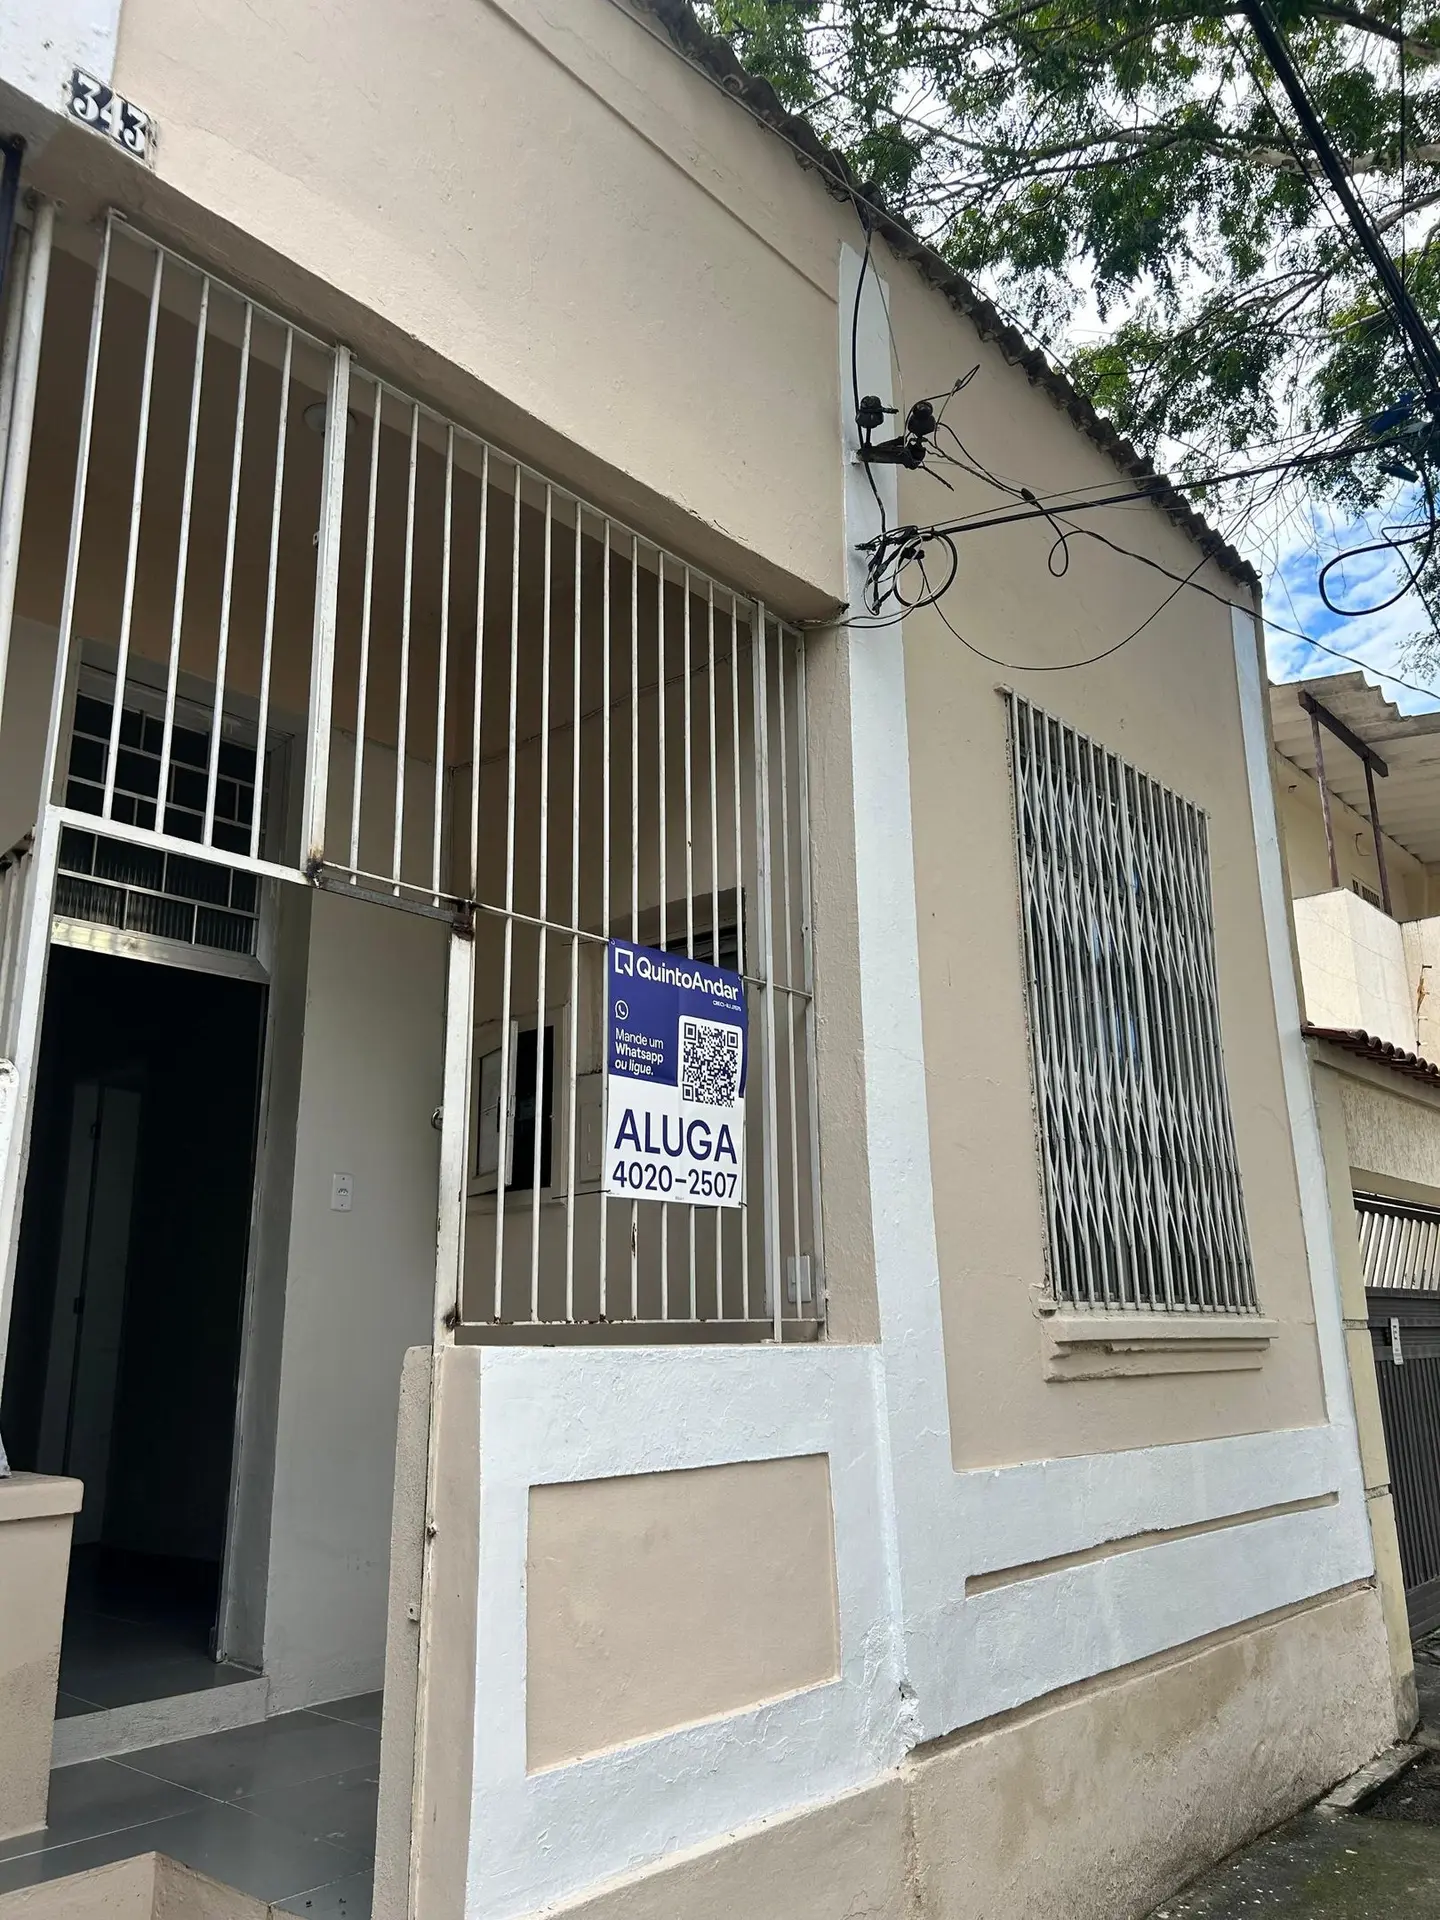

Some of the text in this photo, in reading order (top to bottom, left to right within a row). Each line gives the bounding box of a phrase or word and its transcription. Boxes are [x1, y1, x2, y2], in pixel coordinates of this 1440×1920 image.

[73, 72, 147, 151] 343
[636, 956, 739, 1001] QuintoAndar
[615, 1028, 664, 1049] Mande um
[615, 1041, 664, 1065] Whatsapp
[615, 1059, 654, 1076] ou ligue.
[614, 1108, 738, 1164] ALUGA
[612, 1160, 738, 1198] 4020-2507
